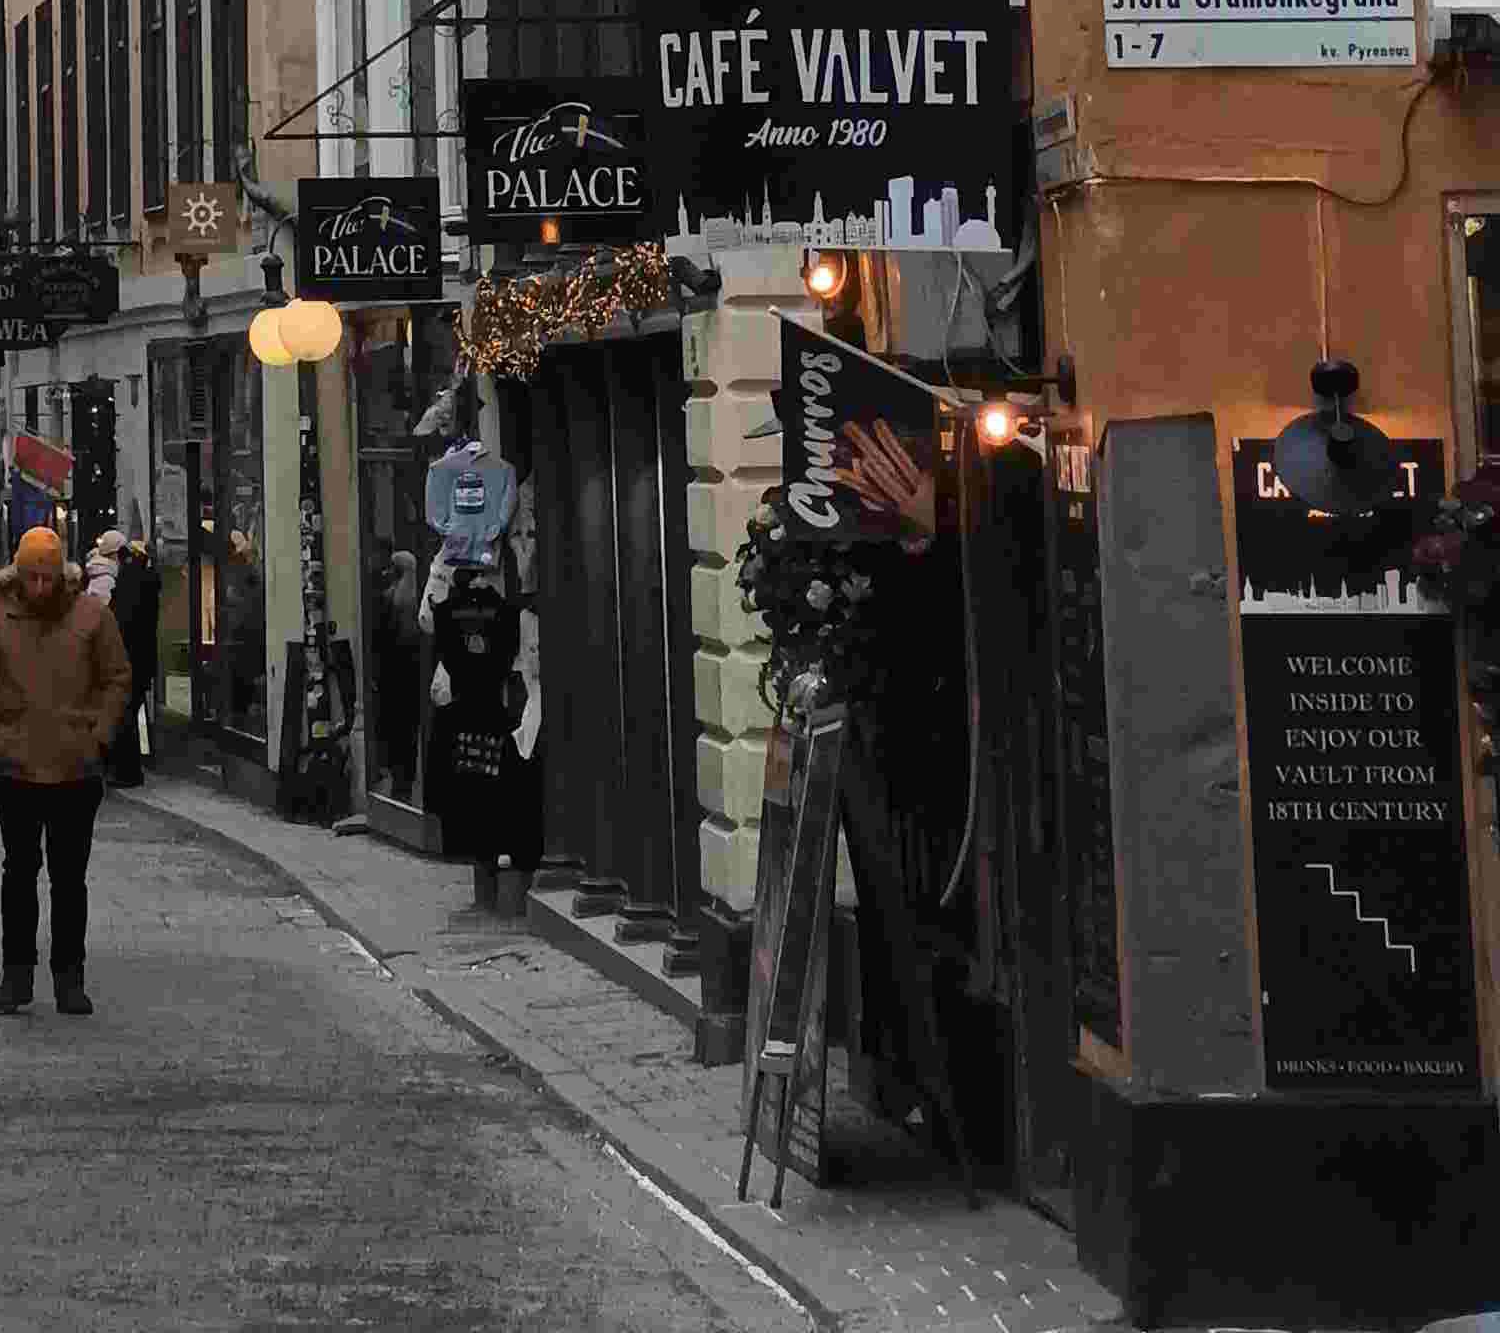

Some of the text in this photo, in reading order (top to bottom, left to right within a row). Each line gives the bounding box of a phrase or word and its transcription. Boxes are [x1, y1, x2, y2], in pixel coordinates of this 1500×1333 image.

[659, 8, 989, 108] CAFÉ VALVET
[492, 115, 558, 163] The
[744, 118, 888, 148] Anno 1980
[485, 166, 643, 210] PALACE
[319, 205, 366, 240] The
[313, 244, 429, 275] PALACE
[787, 349, 843, 529] Churros
[1286, 656, 1413, 676] WELCOME
[1289, 692, 1414, 712] INSIDE TO
[1285, 728, 1425, 754] ENJOY OUR
[1275, 764, 1436, 785] VAULT FROM
[1267, 801, 1449, 821] 18TH CENTURY
